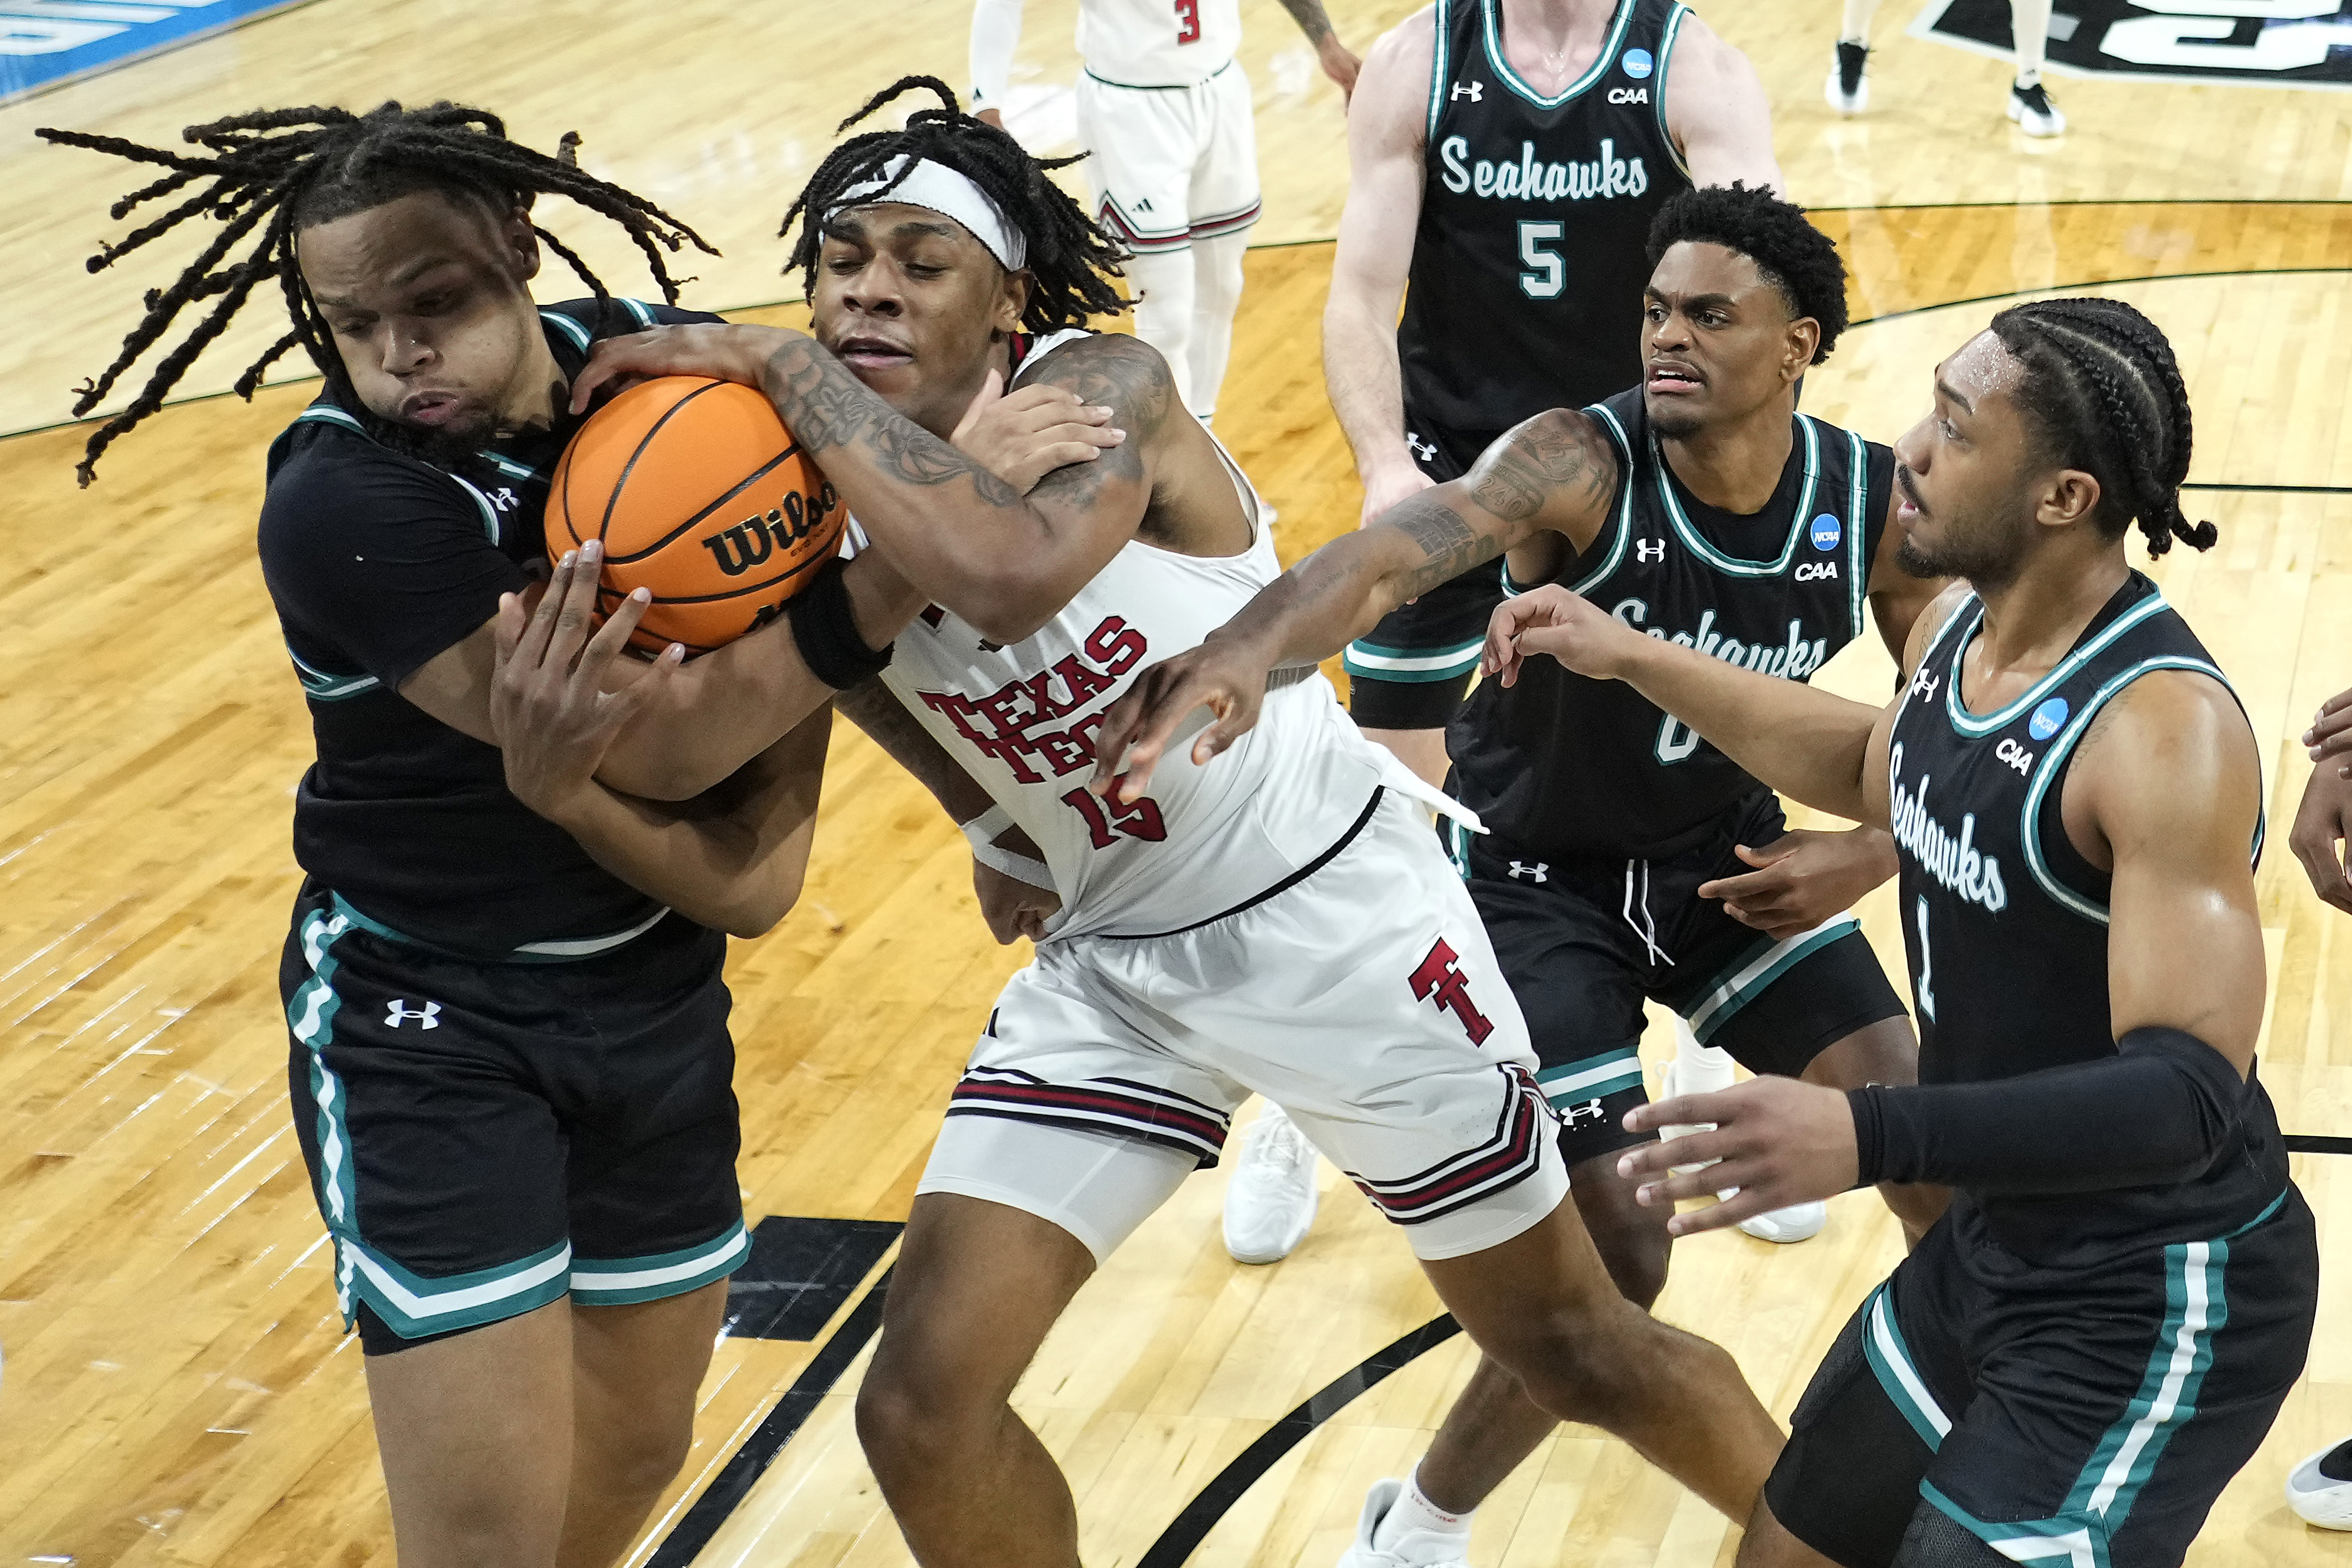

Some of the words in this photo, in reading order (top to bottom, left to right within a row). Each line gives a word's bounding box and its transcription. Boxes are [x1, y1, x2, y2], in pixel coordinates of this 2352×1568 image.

[1174, 0, 1201, 45] 3
[1607, 88, 1649, 104] CAA
[1440, 135, 1649, 201] Seahawks
[1517, 220, 1567, 300] 5
[702, 480, 837, 576] Wilso
[1814, 531, 1840, 543] NCAA
[1794, 561, 1839, 582] CAA
[916, 614, 1148, 742] TEXAS
[968, 702, 1139, 785] TEC
[1995, 737, 2034, 777] CAA
[1060, 771, 1168, 851] 15
[1889, 740, 2008, 913] Seahawks
[1916, 894, 1936, 1024] 1
